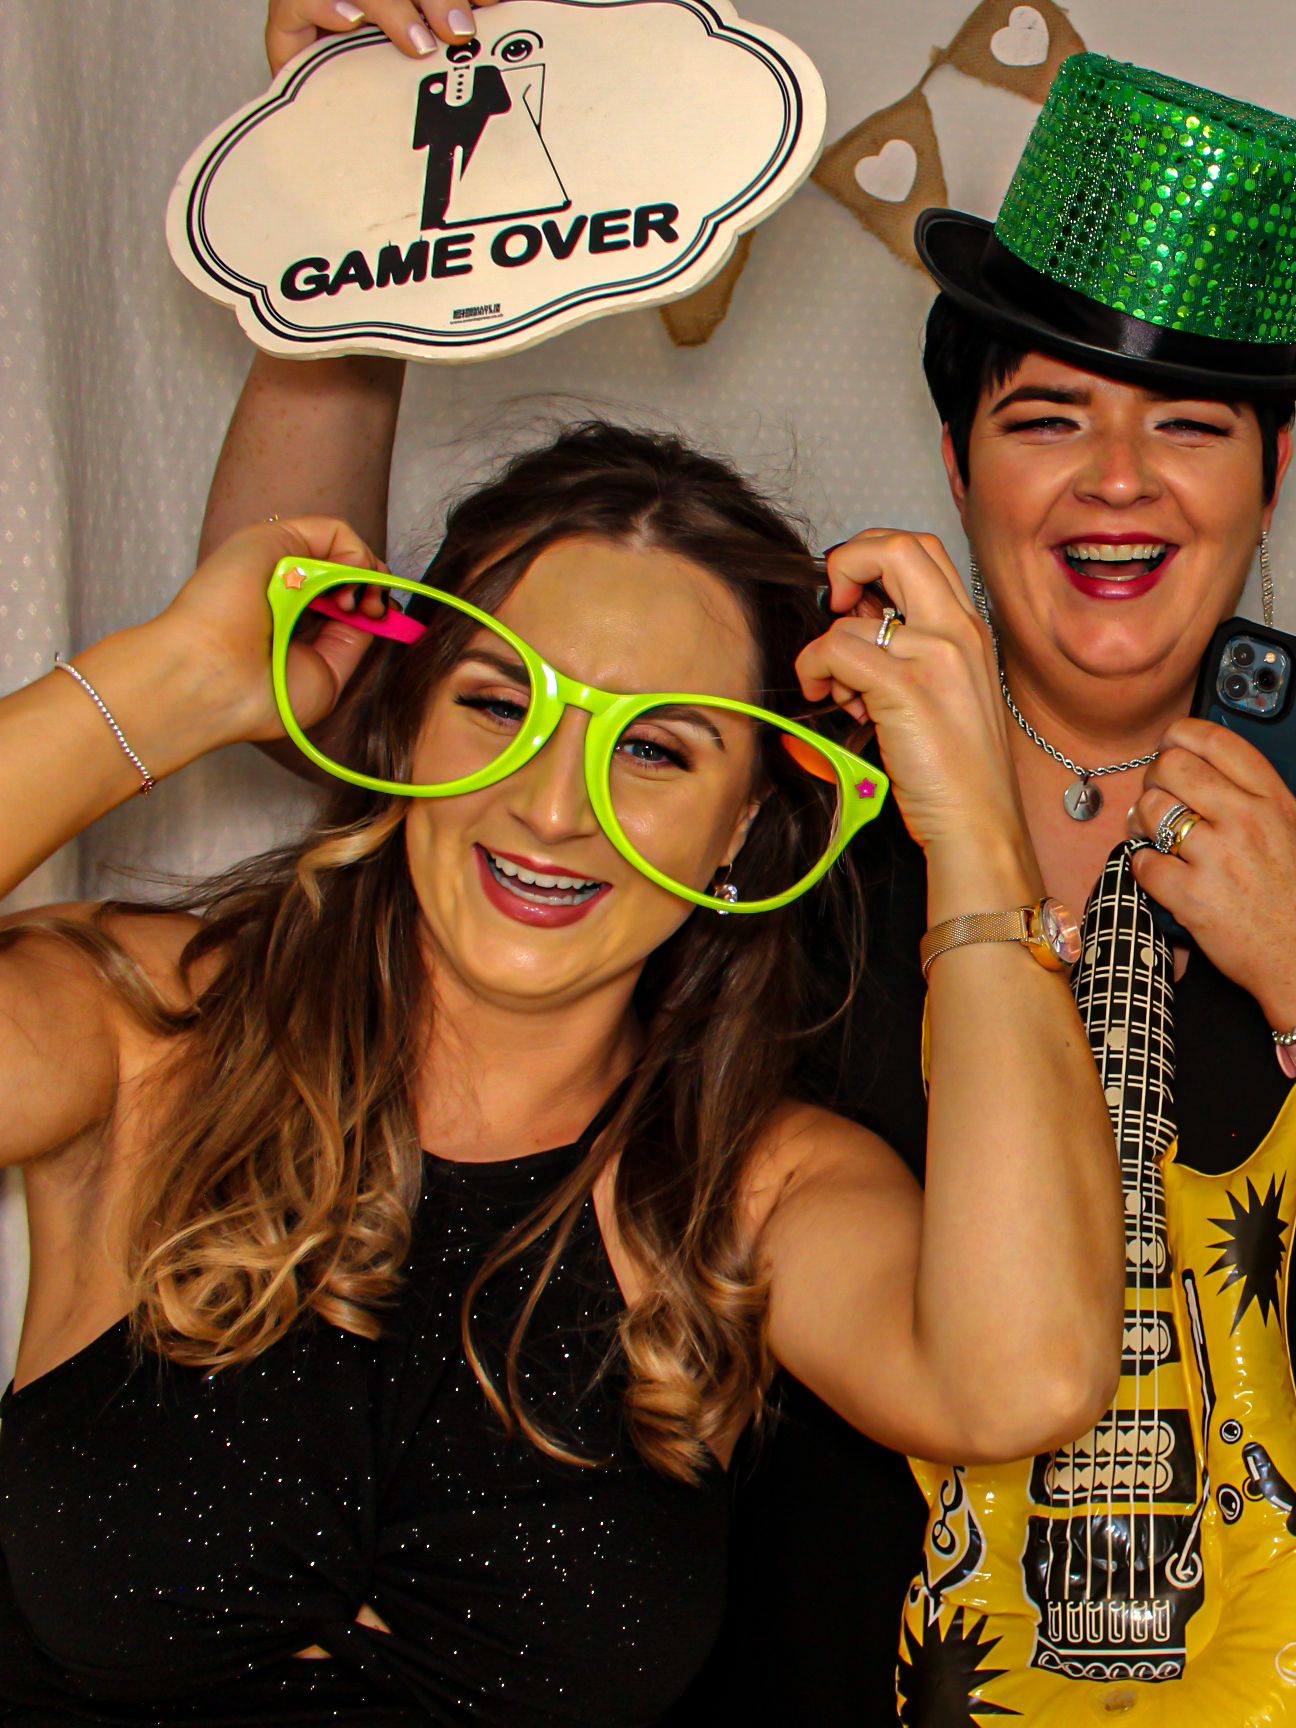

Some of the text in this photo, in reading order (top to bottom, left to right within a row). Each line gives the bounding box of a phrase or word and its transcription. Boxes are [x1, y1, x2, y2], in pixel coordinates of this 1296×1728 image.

[280, 202, 679, 302] GAME OVER
[1074, 790, 1093, 812] A
